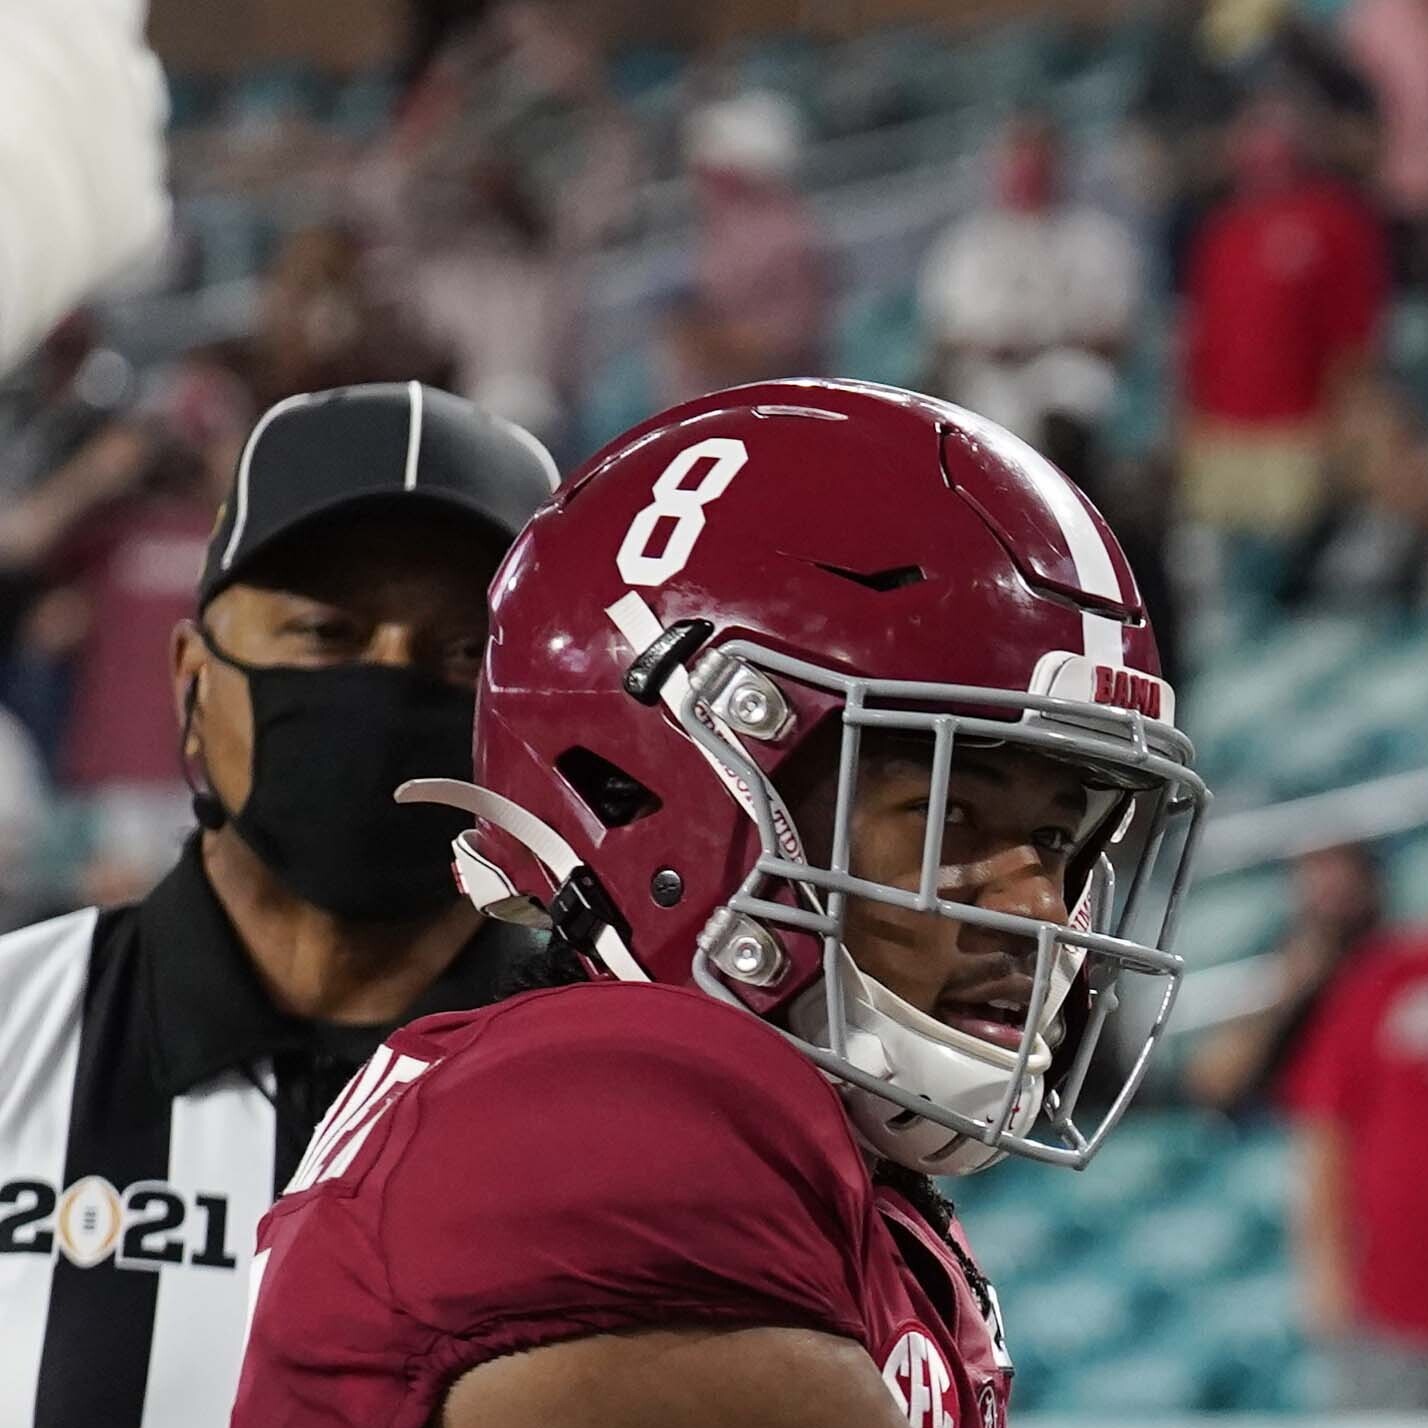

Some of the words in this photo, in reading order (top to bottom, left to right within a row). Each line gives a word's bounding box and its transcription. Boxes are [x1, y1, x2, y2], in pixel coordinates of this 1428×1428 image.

[616, 437, 748, 587] 8
[1094, 665, 1161, 720] BAMA
[0, 1176, 237, 1269] 2021
